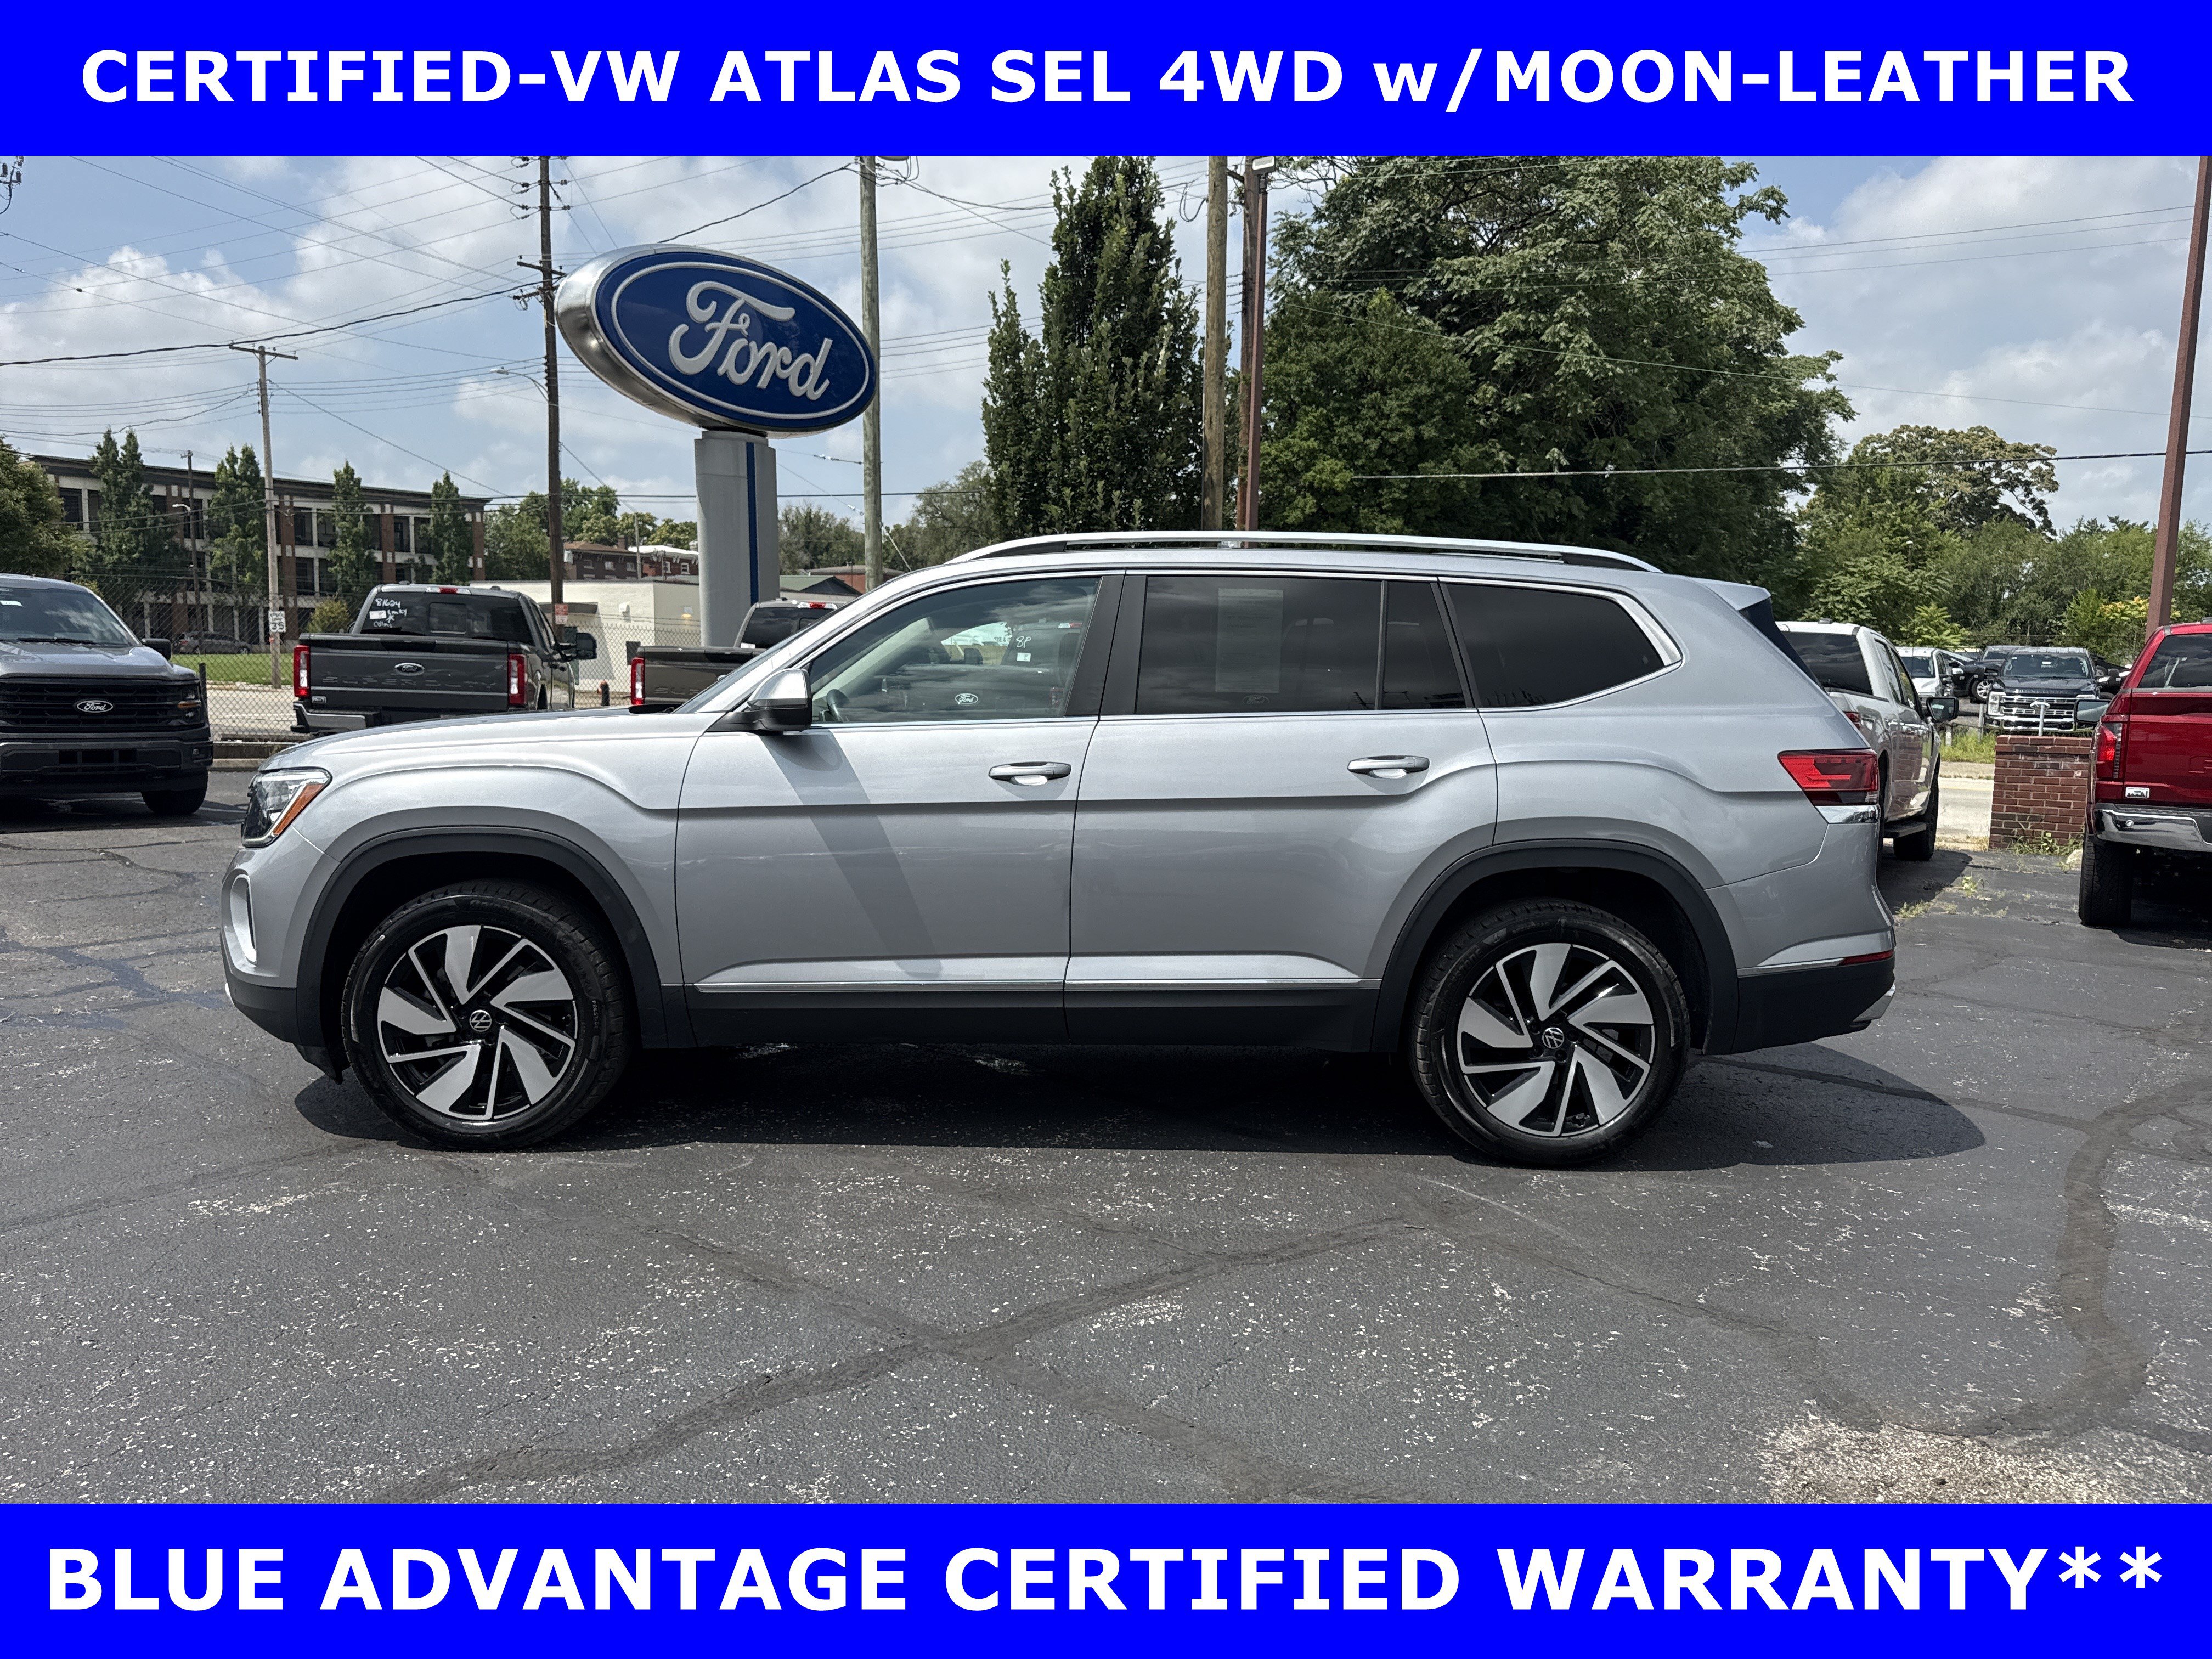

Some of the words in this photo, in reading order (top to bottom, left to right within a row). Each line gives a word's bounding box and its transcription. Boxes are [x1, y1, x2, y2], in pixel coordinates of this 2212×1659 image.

[669, 280, 833, 401] Ford
[272, 622, 284, 630] 35
[958, 695, 974, 703] Ford
[84, 702, 107, 710] Ford
